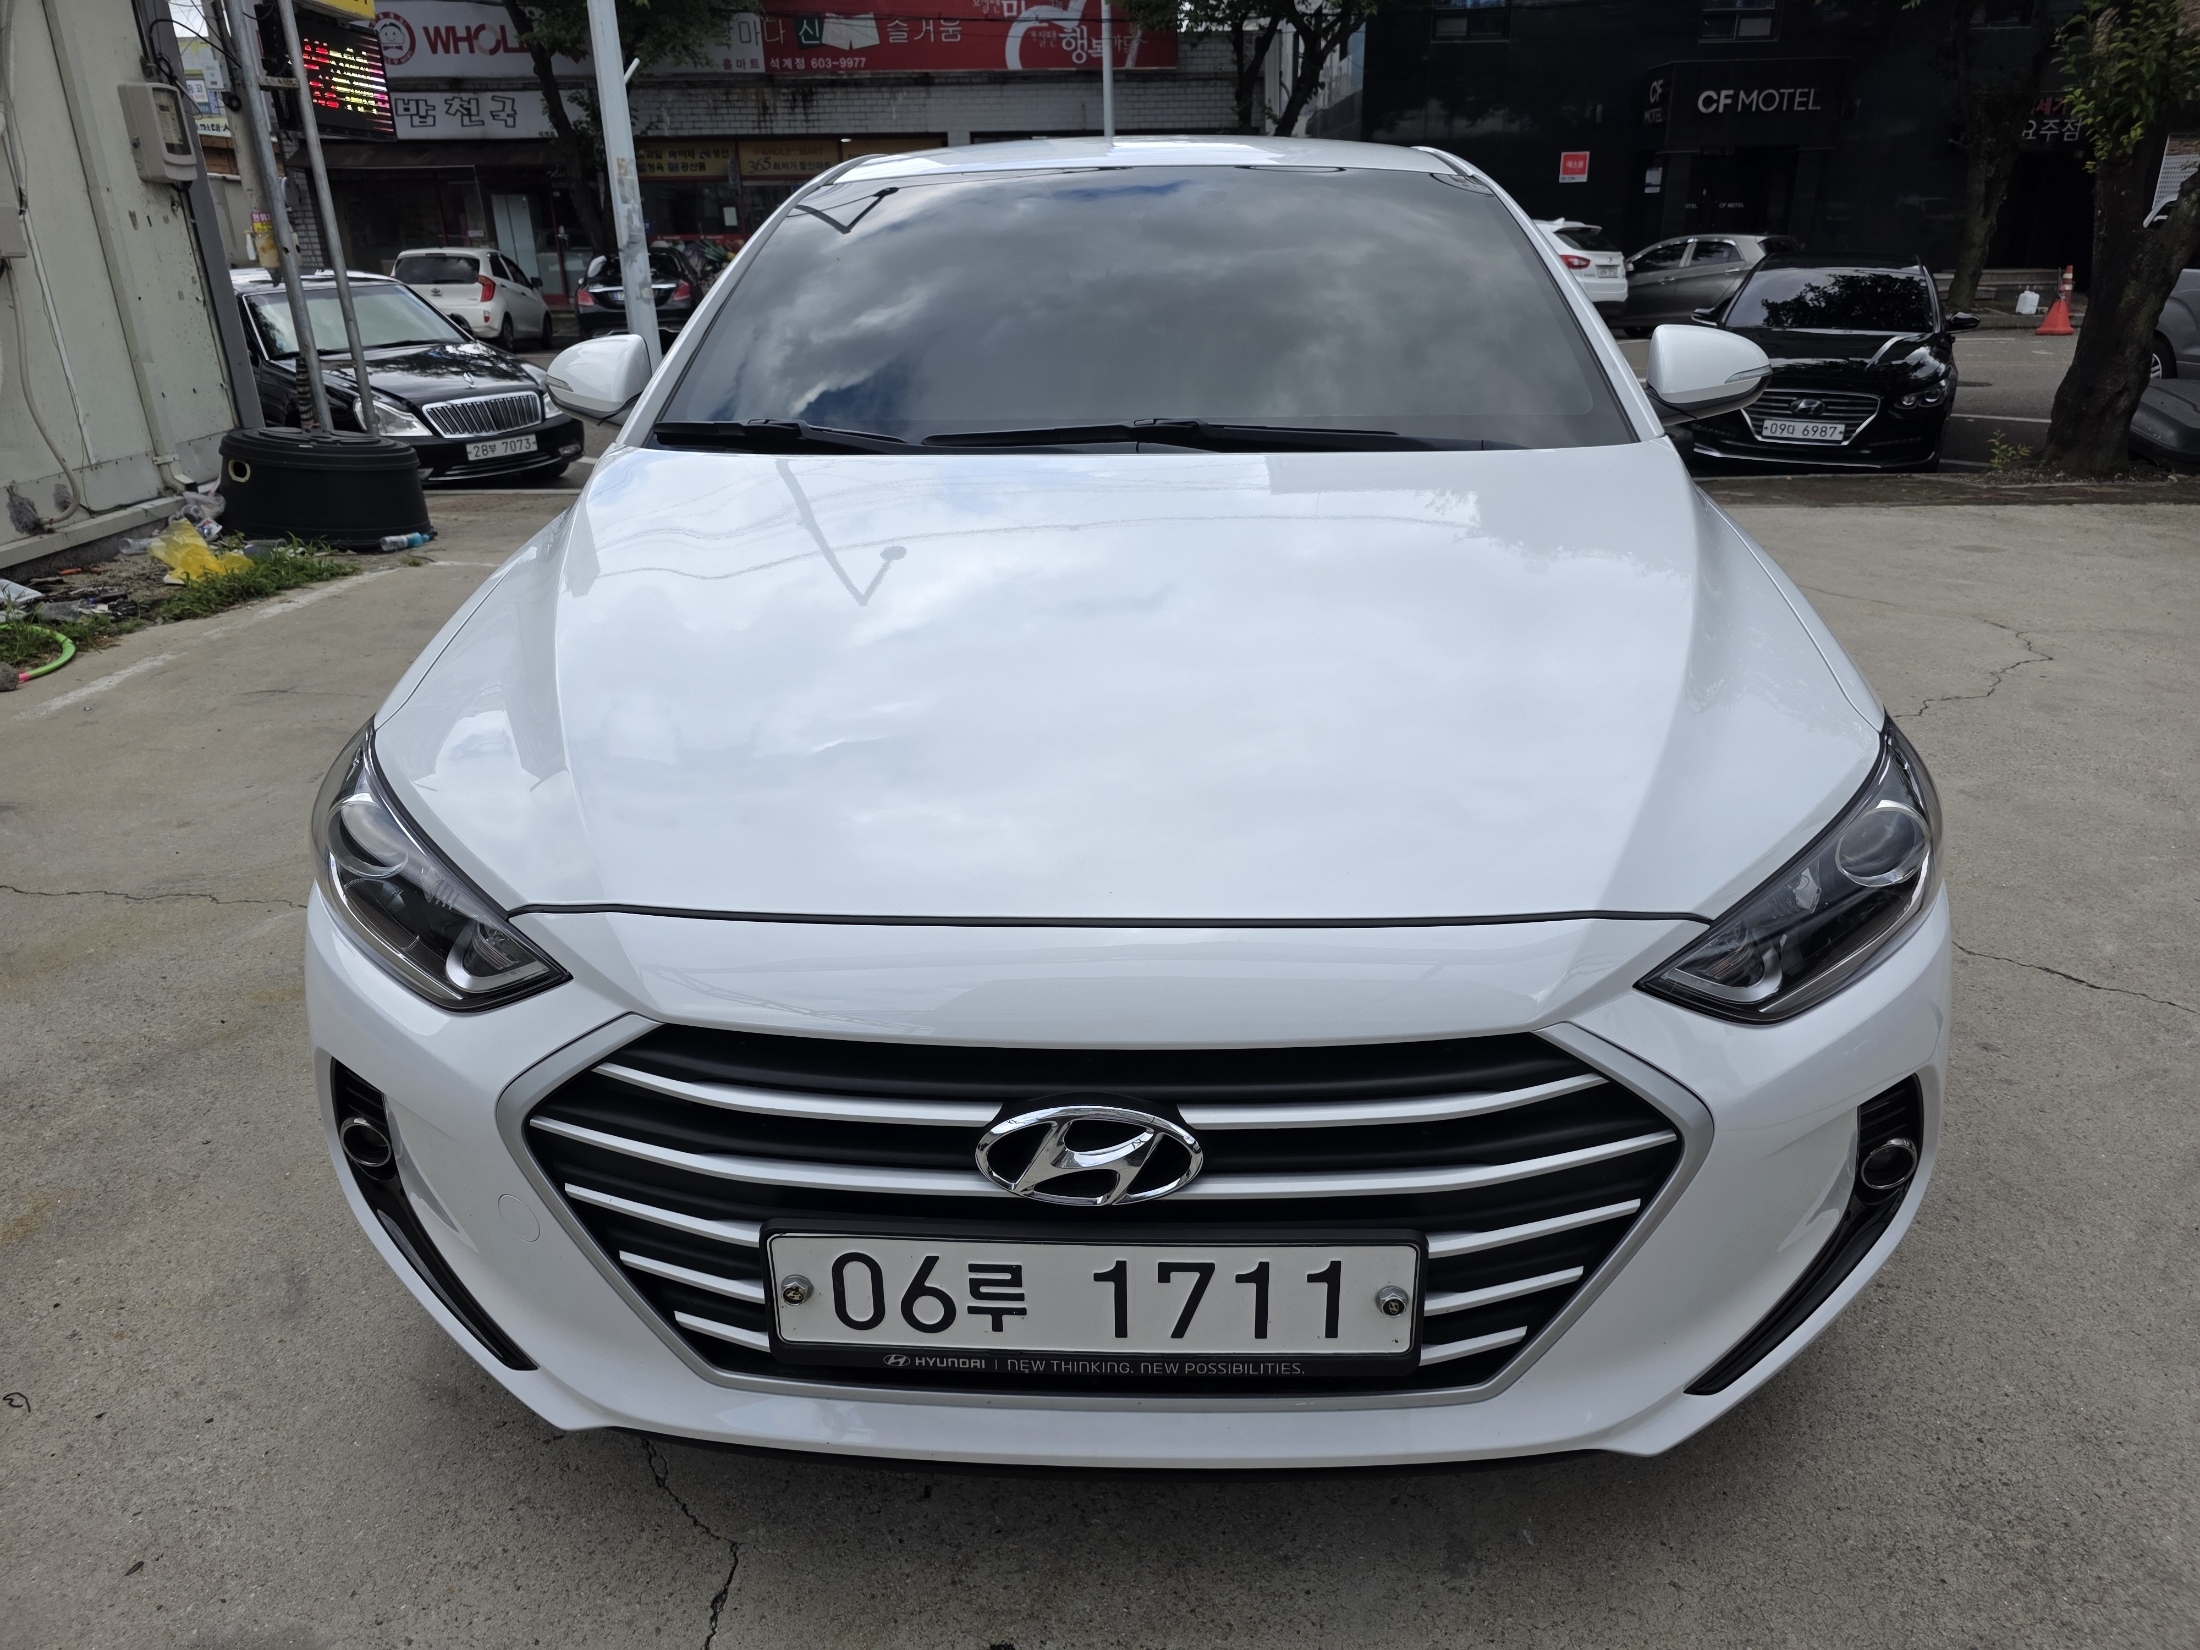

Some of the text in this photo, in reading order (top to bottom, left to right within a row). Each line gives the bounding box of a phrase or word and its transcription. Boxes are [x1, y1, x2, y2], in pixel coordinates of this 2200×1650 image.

[726, 18, 786, 46] 마다
[769, 57, 805, 70] 석계점
[810, 57, 866, 70] 603-9977
[1650, 79, 1664, 104] CF
[1697, 88, 1821, 114] CF MOTEL
[1643, 107, 1663, 125] MOTEL
[747, 157, 772, 174] 365
[1801, 424, 1837, 437] 6987
[473, 438, 532, 458] 28부 7073
[831, 1251, 1344, 1341] 06루 1711
[915, 1356, 986, 1369] HYUNDAI
[1006, 1358, 1046, 1373] NEW
[1139, 1361, 1180, 1376] NEW
[1183, 1361, 1306, 1376] POSSIBILITIES.
